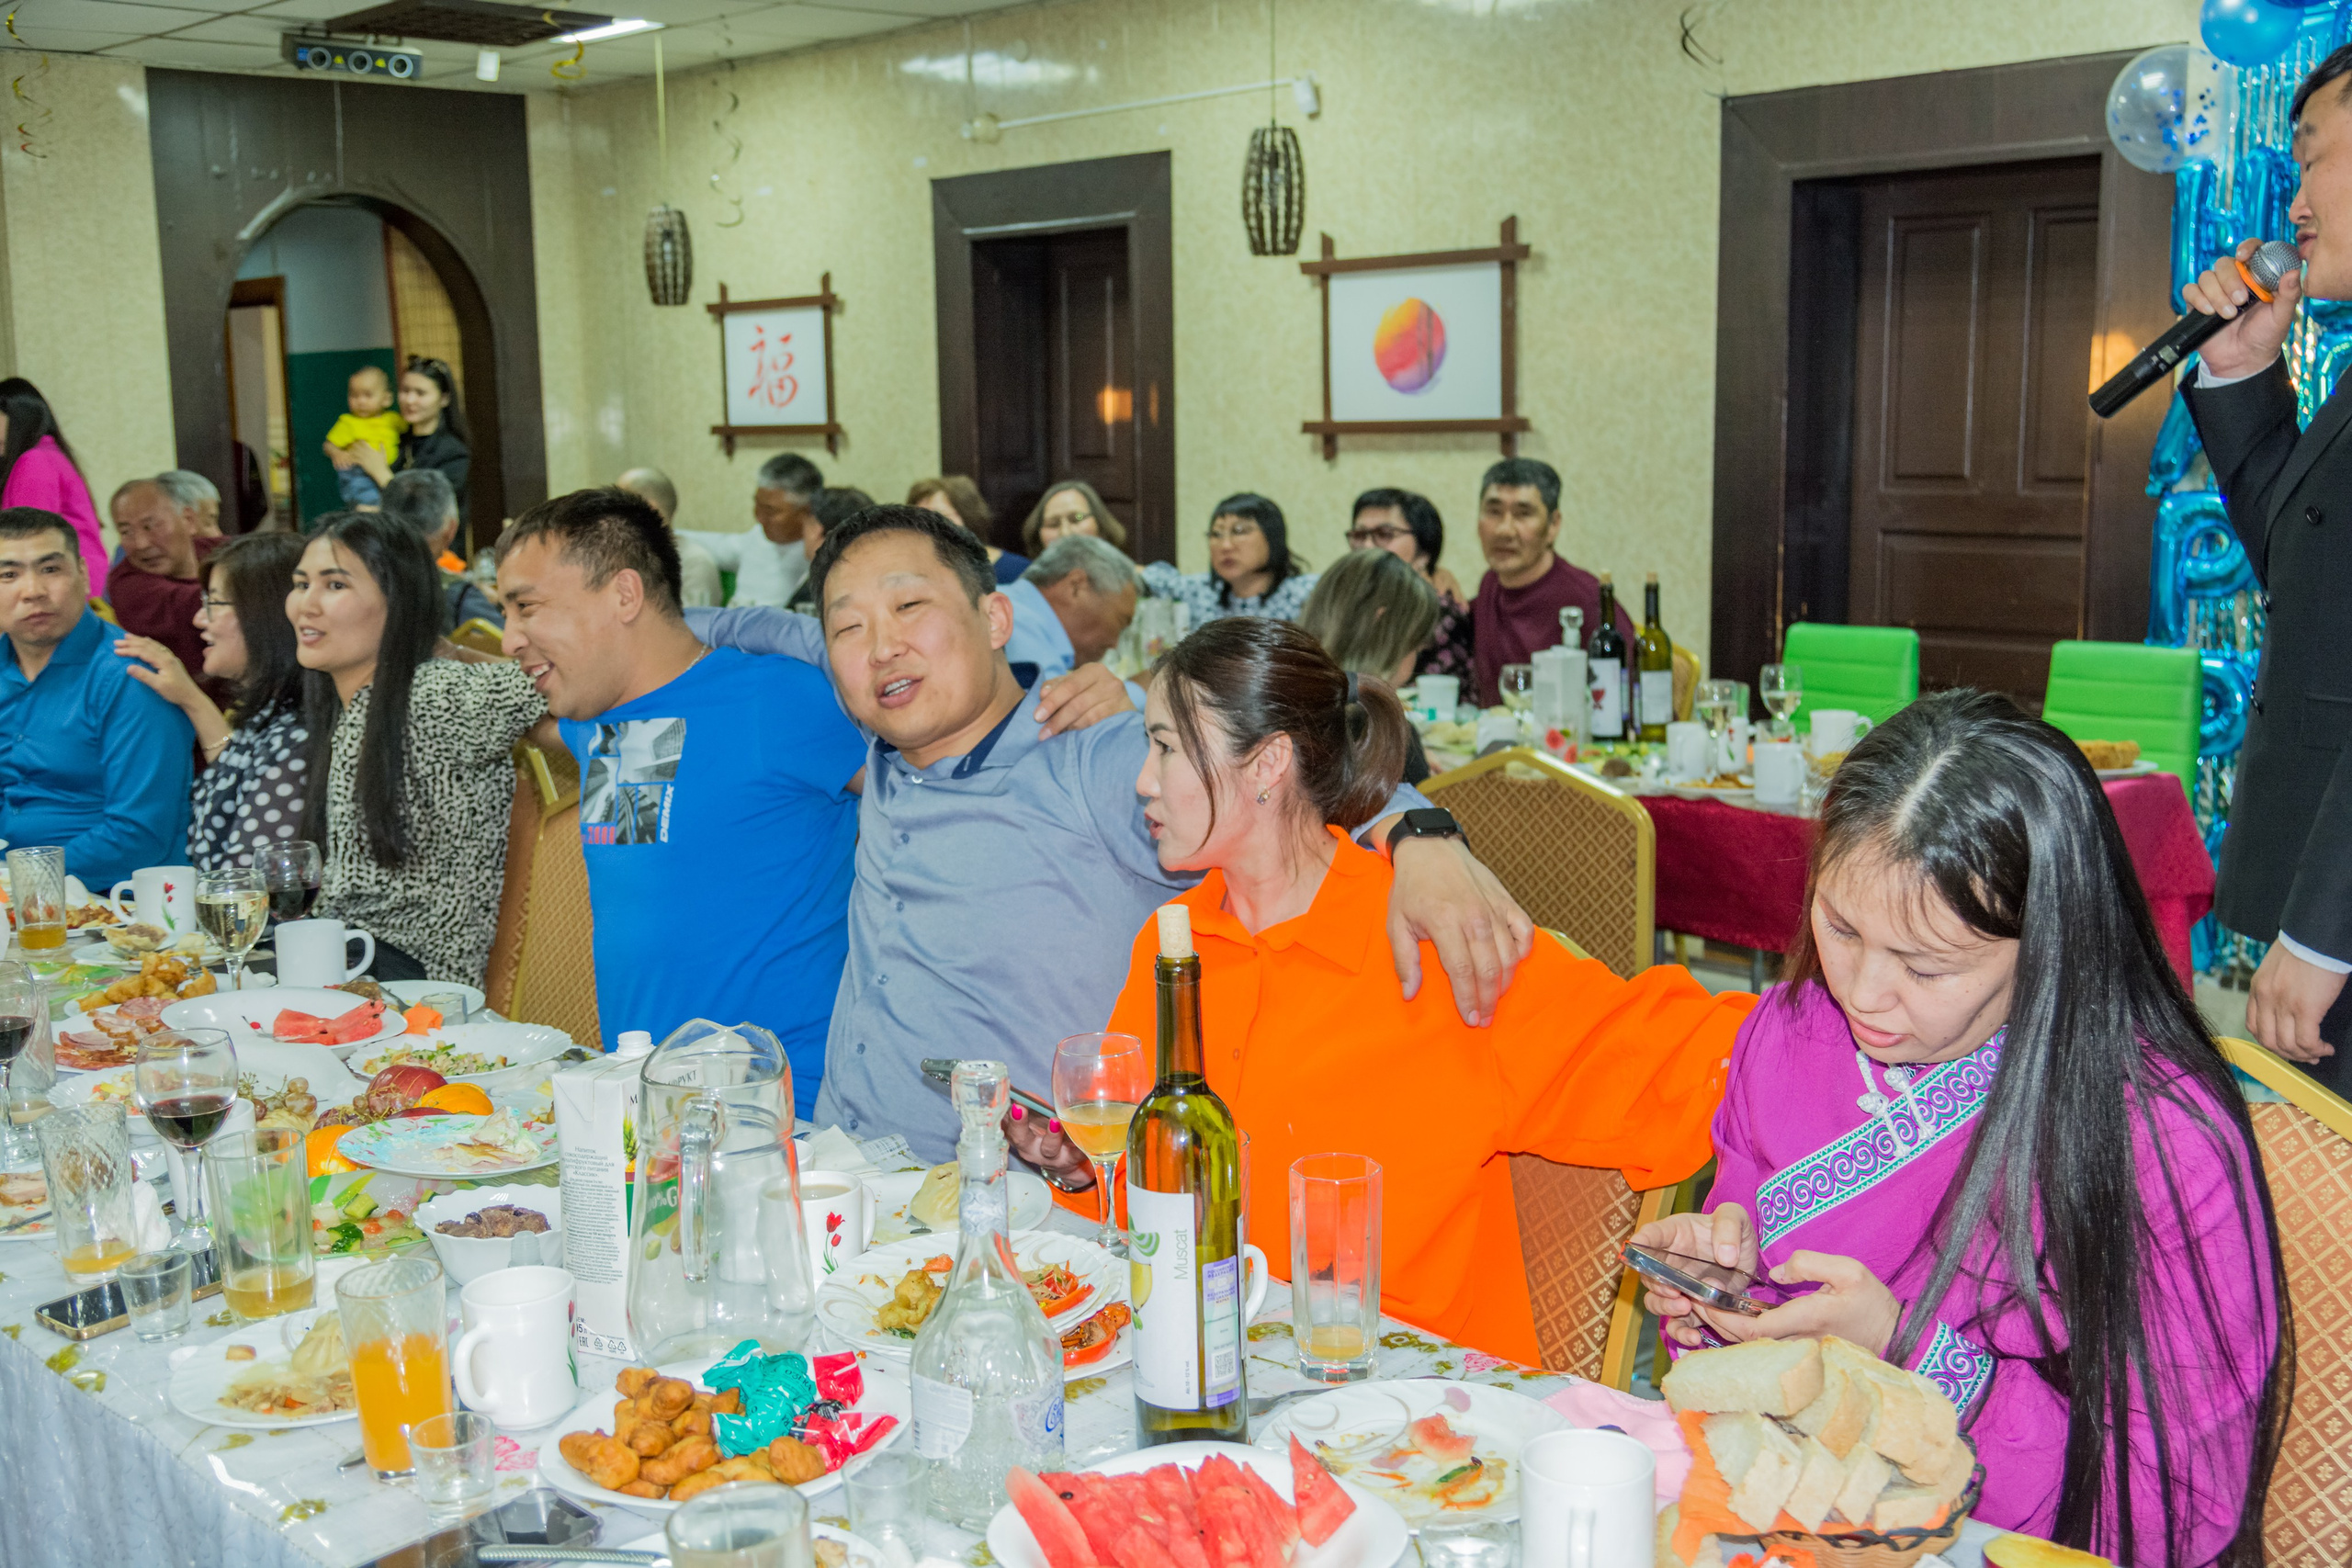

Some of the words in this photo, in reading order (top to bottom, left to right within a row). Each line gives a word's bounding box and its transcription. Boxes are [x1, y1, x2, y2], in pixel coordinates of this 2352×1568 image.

[748, 323, 798, 410] 福
[660, 783, 675, 843] DEMIX
[574, 1145, 596, 1154] Напиток
[1173, 1228, 1187, 1280] Muscat
